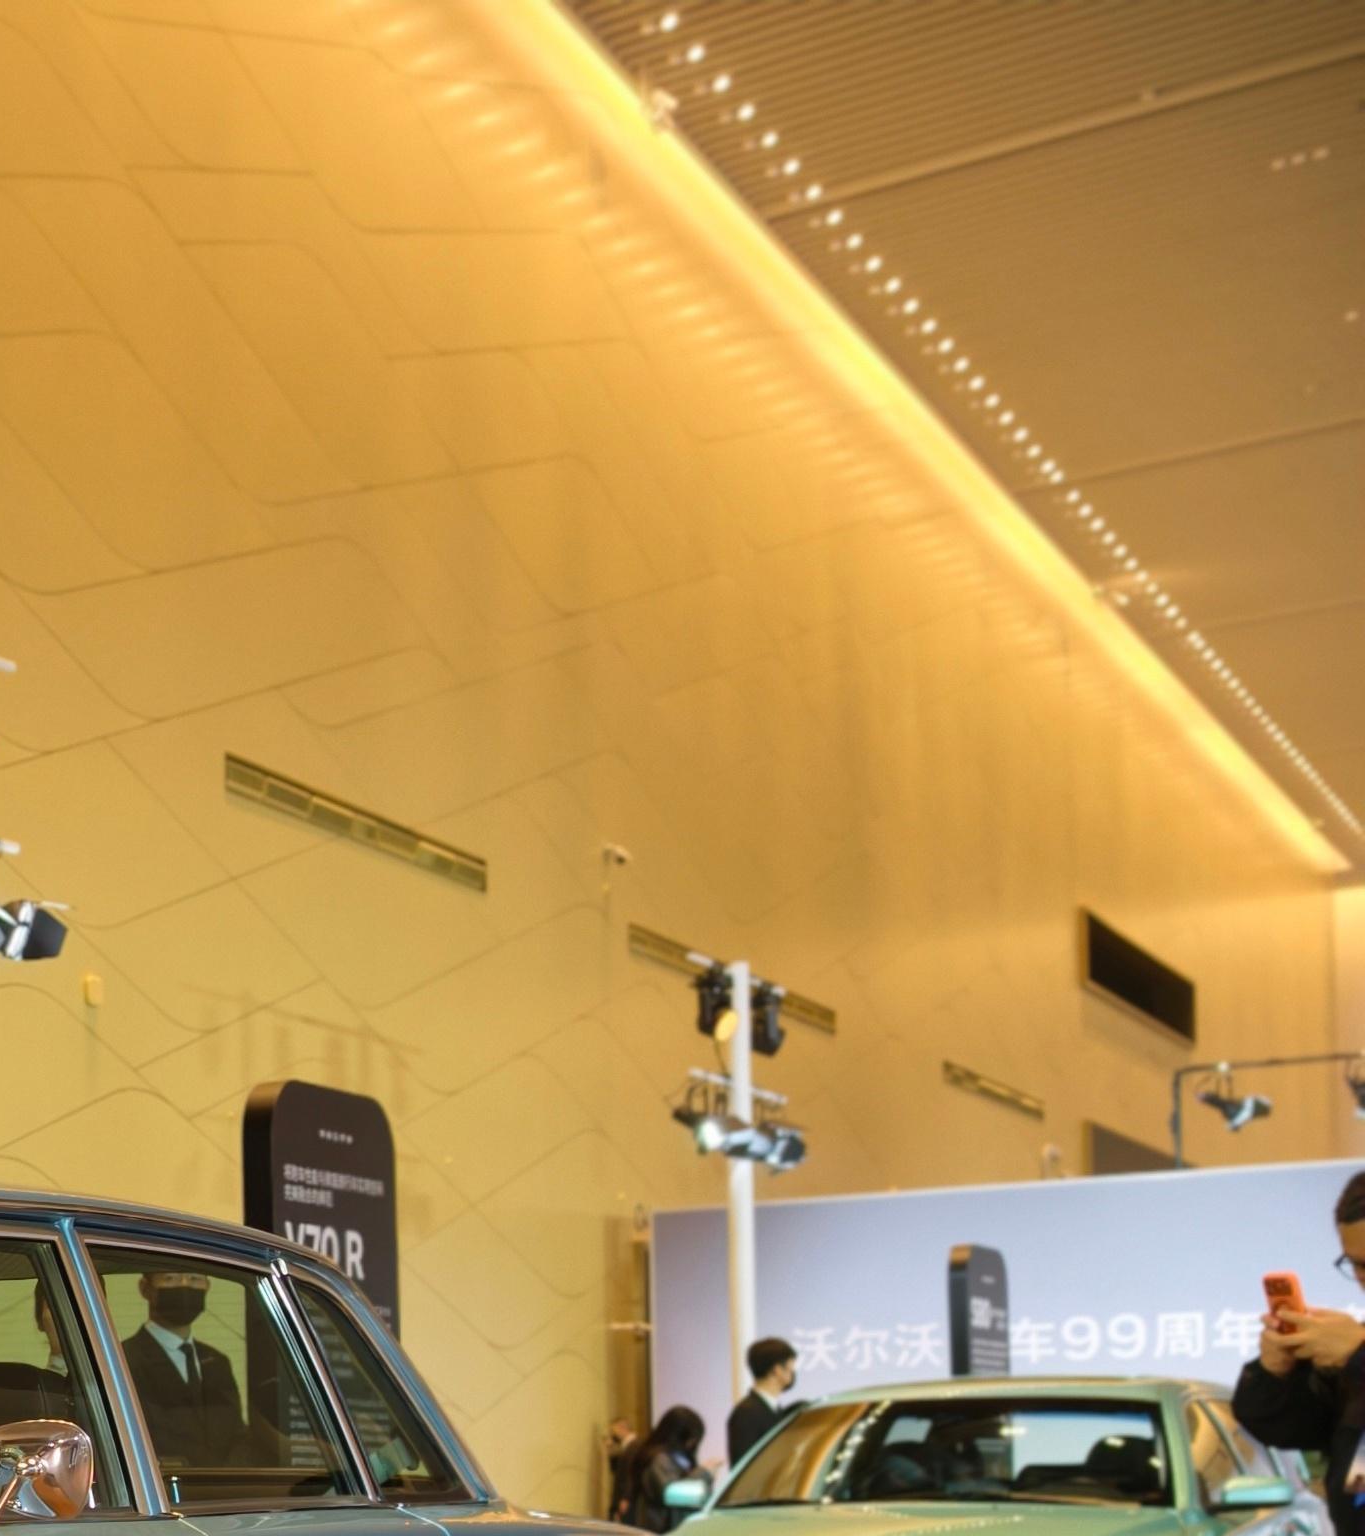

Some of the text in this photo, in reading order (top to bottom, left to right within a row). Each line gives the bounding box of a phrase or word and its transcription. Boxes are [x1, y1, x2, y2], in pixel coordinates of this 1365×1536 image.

[346, 1229, 365, 1281] R
[793, 1309, 1261, 1373] 沃尔沃车99周年
